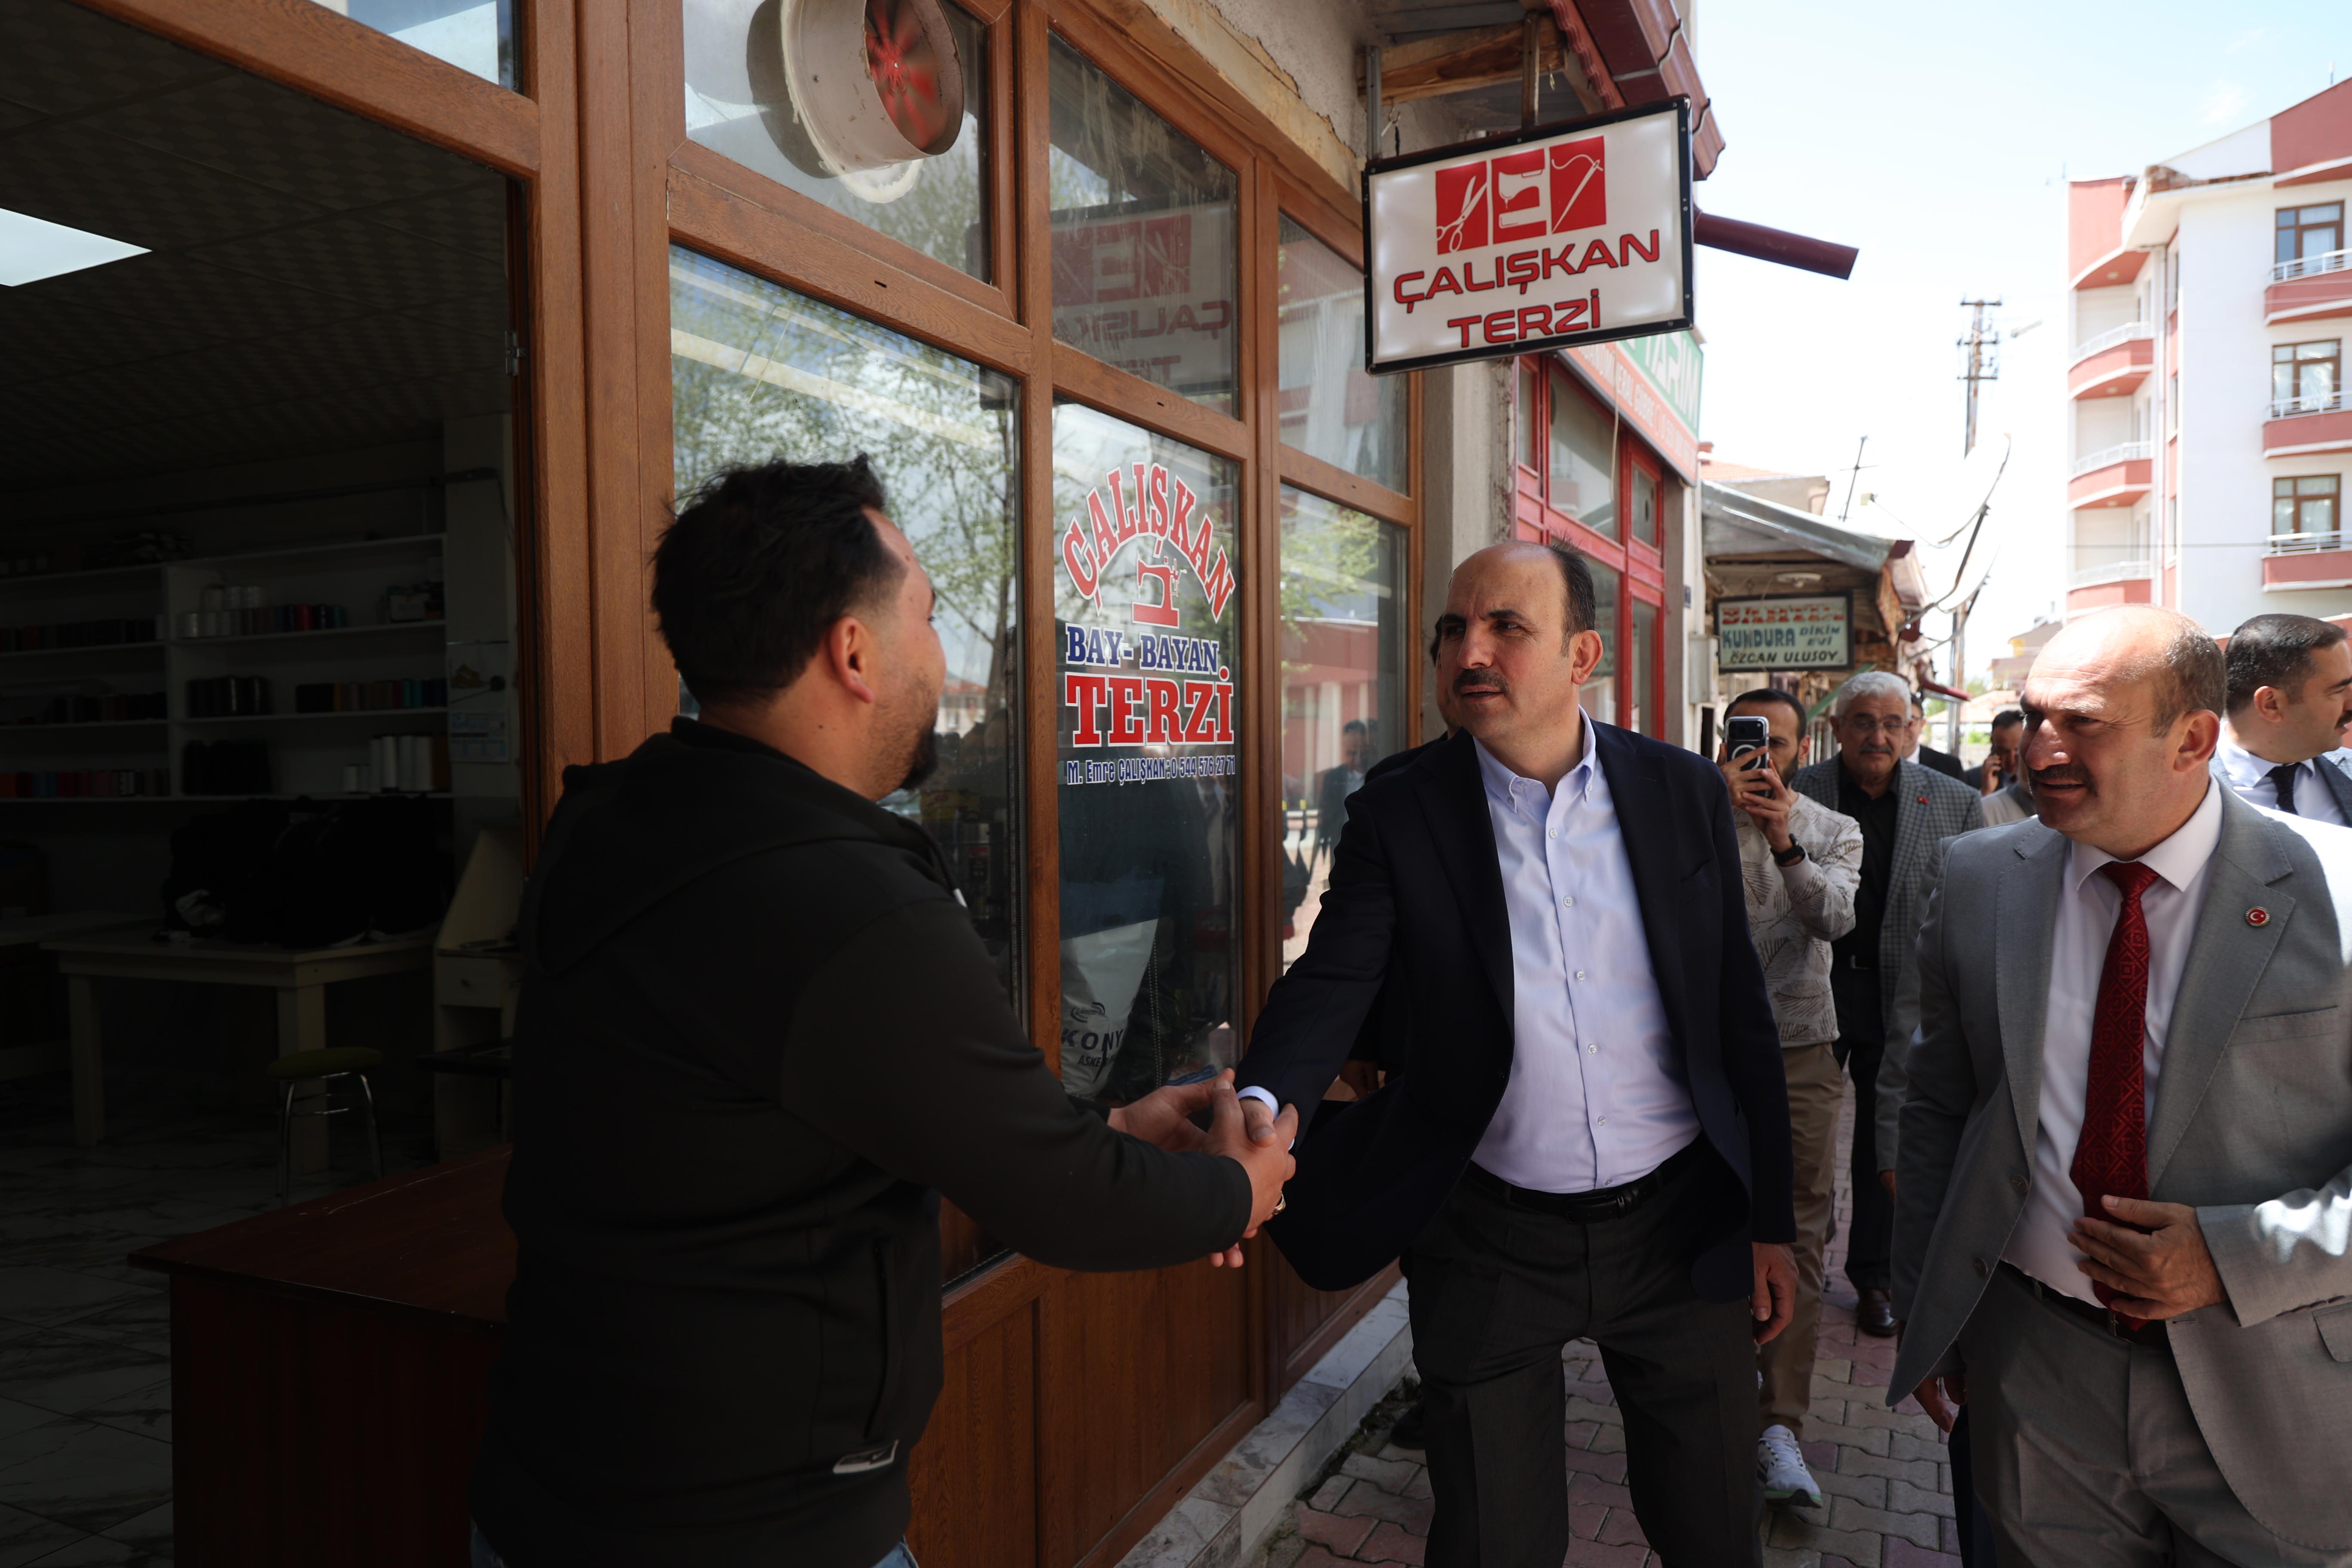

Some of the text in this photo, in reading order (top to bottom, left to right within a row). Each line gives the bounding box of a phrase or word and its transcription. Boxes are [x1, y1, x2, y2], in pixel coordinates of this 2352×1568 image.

[1394, 230, 1660, 313] ÇALIŞKAN
[1448, 289, 1601, 347] TERZİ
[1139, 631, 1219, 675] BAYAN
[1723, 628, 1796, 648] KUNDURA
[1784, 650, 1838, 663] ULUSOY
[1065, 665, 1234, 747] TERZİ
[1067, 760, 1083, 785] M.
[1085, 760, 1115, 784] Emre
[1179, 756, 1197, 778] 544
[1198, 756, 1214, 777] 576
[1215, 755, 1225, 775] 27
